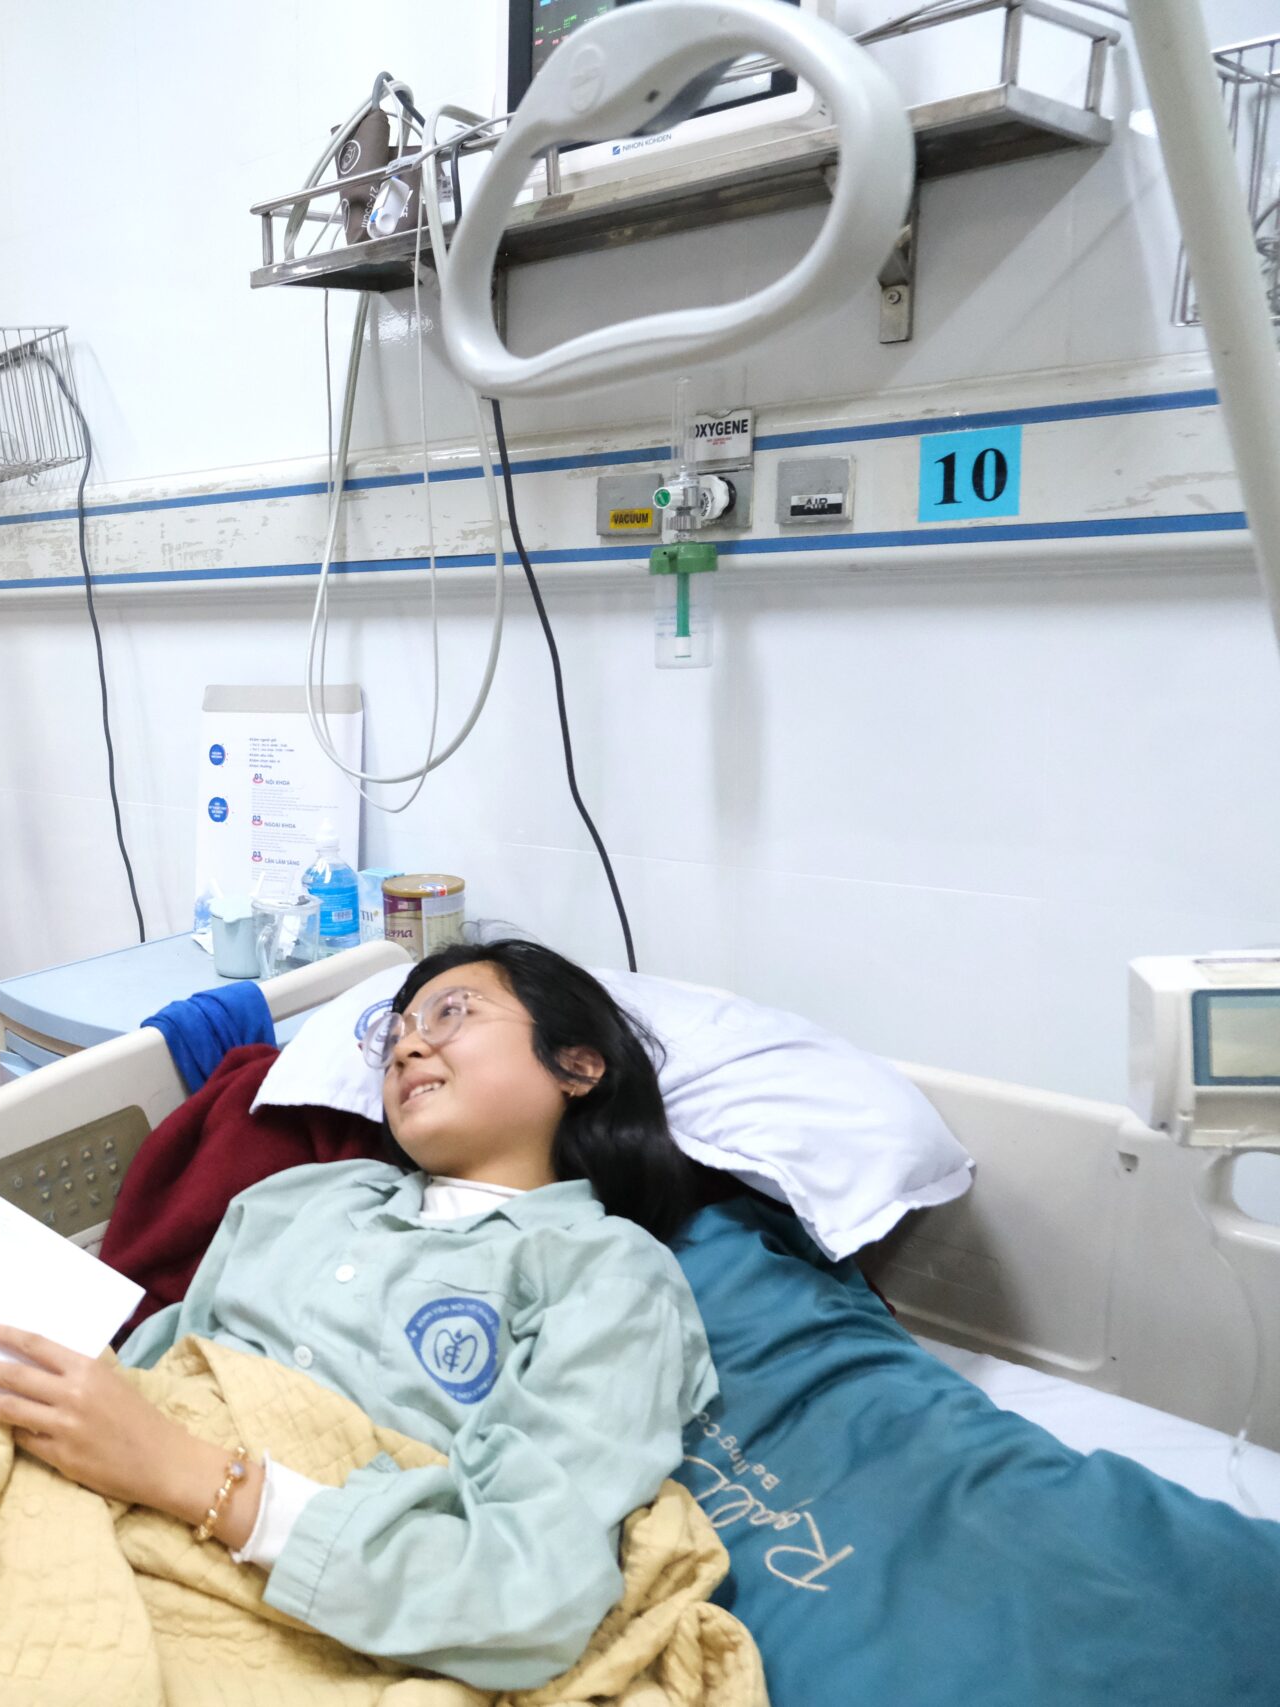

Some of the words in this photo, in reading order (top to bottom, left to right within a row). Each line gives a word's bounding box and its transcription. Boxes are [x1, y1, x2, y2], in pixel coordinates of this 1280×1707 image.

[622, 142, 644, 152] NIHON
[645, 133, 672, 146] KOHDEN
[934, 447, 1007, 506] 10
[804, 497, 828, 510] AIR
[613, 512, 649, 525] VACUUM
